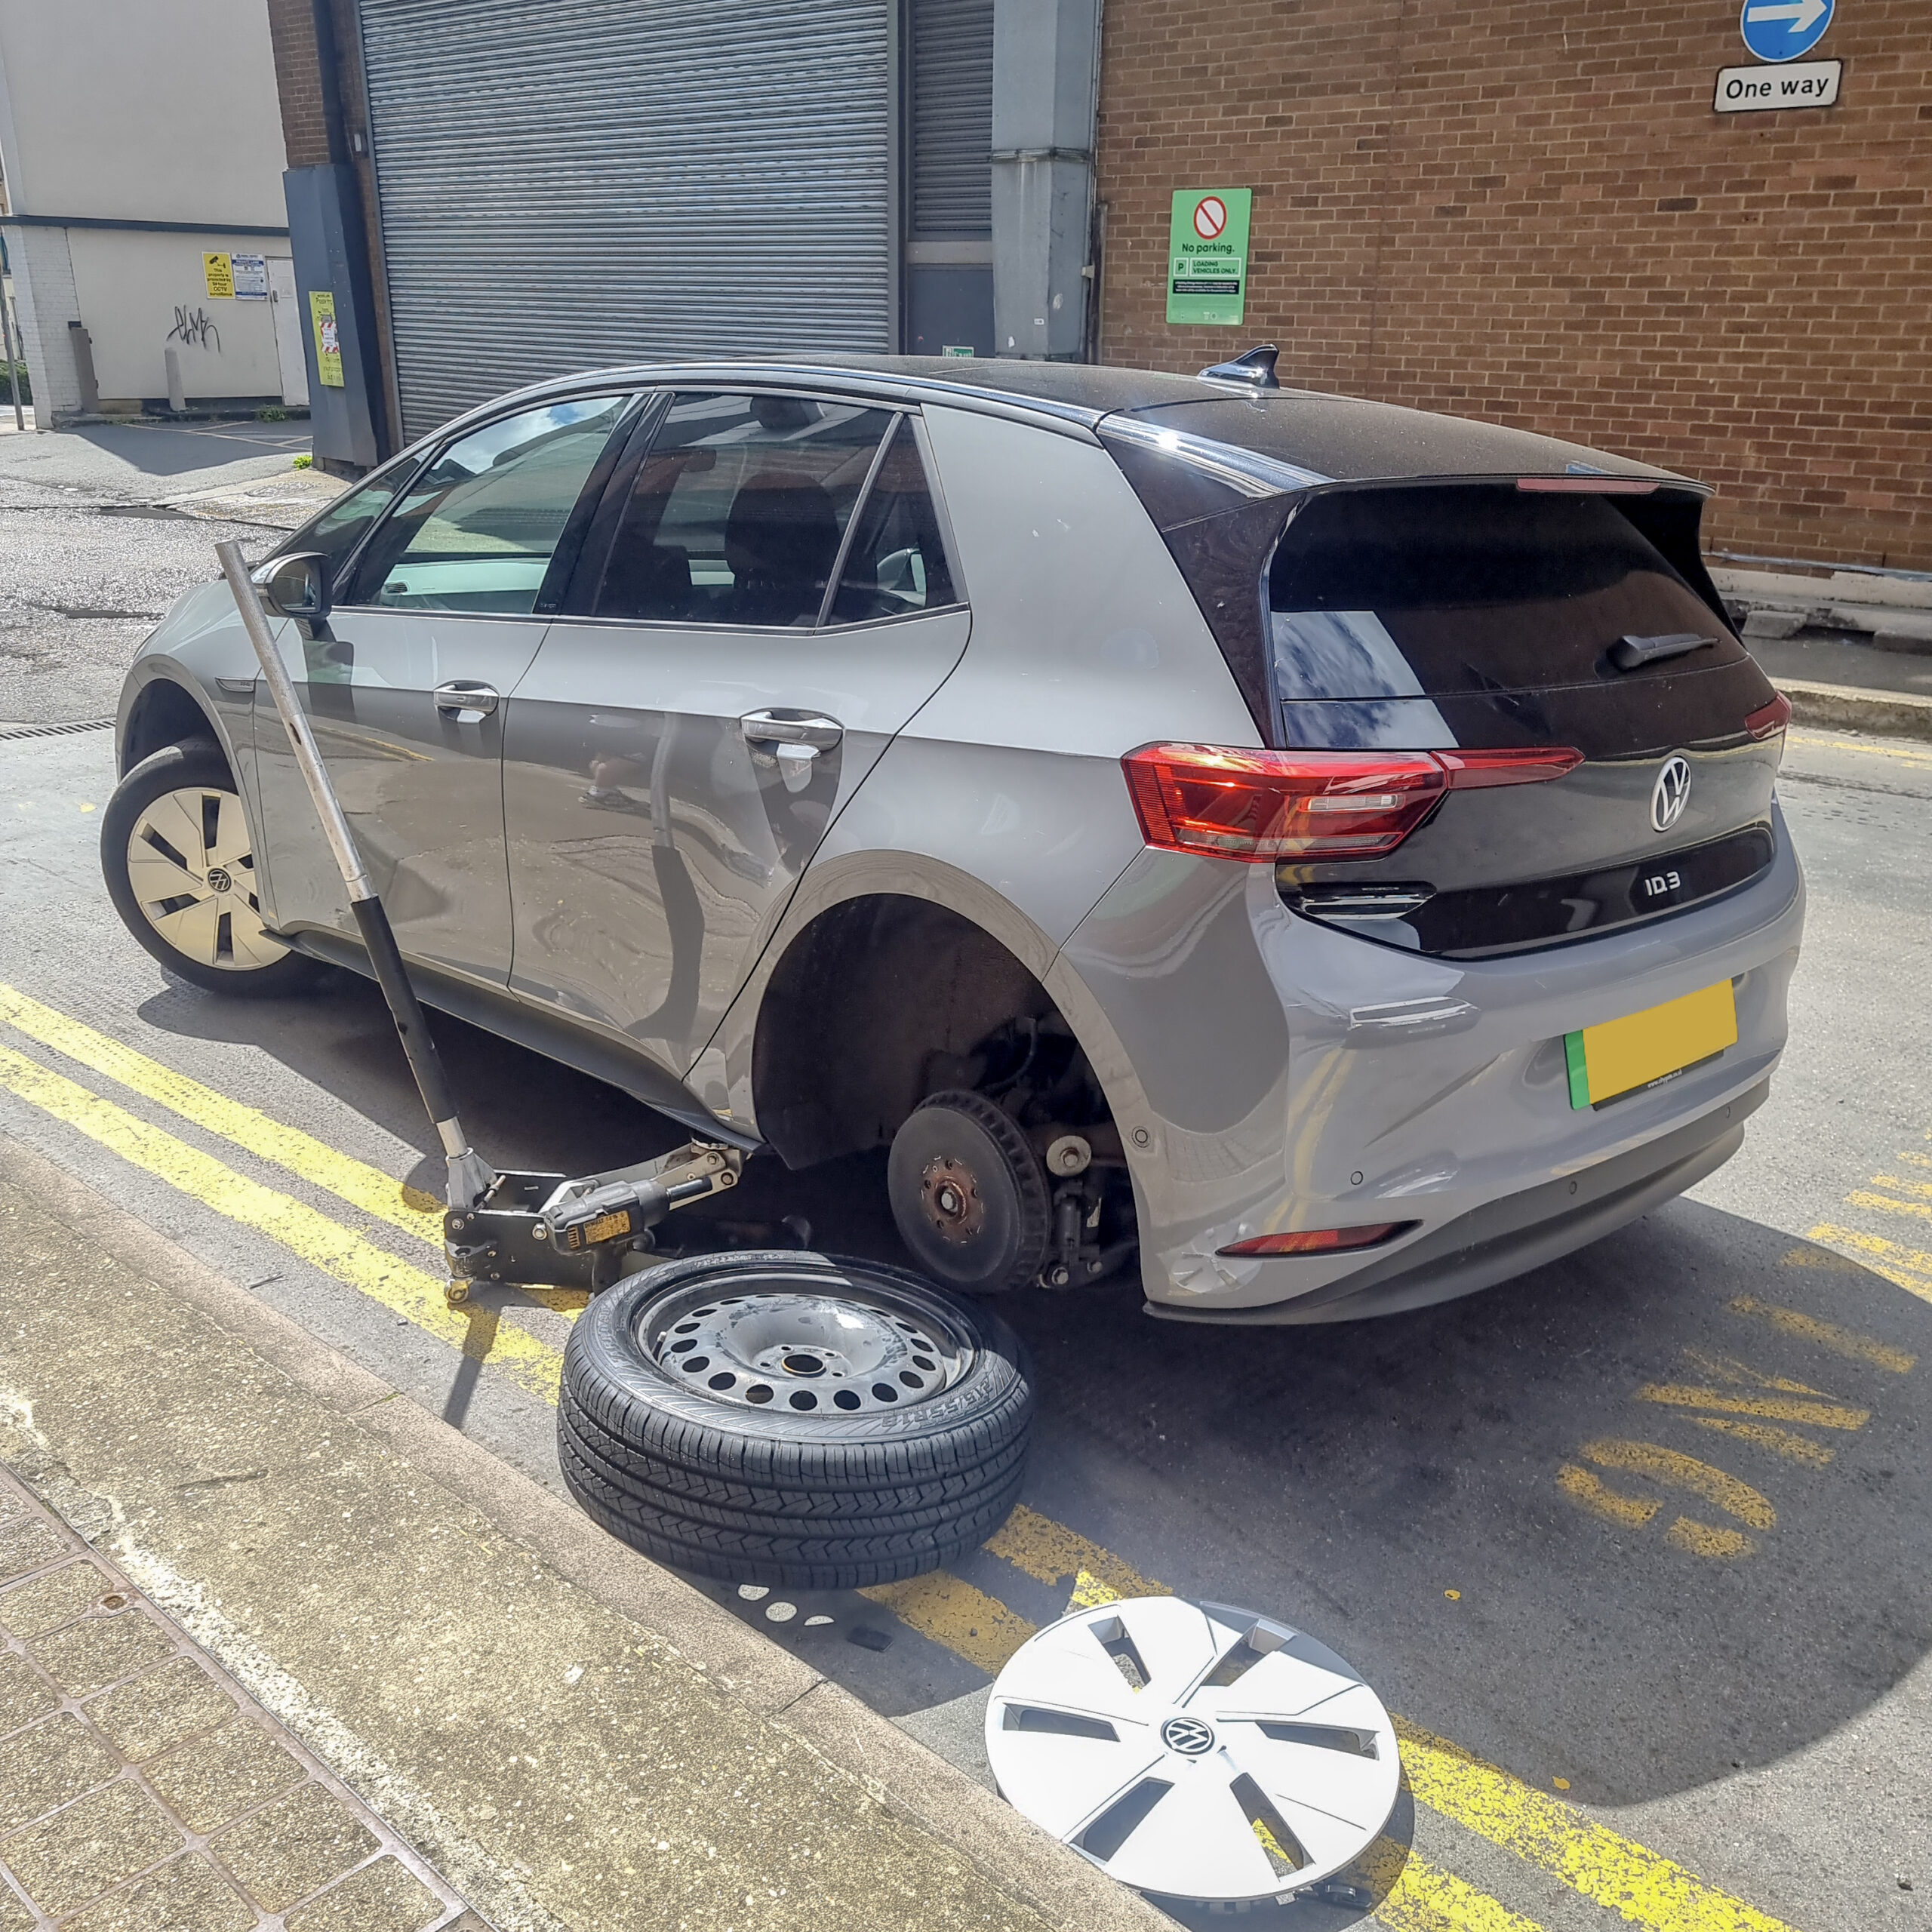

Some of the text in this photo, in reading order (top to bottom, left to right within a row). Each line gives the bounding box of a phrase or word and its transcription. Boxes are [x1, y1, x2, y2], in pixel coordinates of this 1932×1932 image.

[1726, 78, 1829, 99] One way
[1182, 243, 1235, 254] No parking.
[1178, 263, 1184, 271] P
